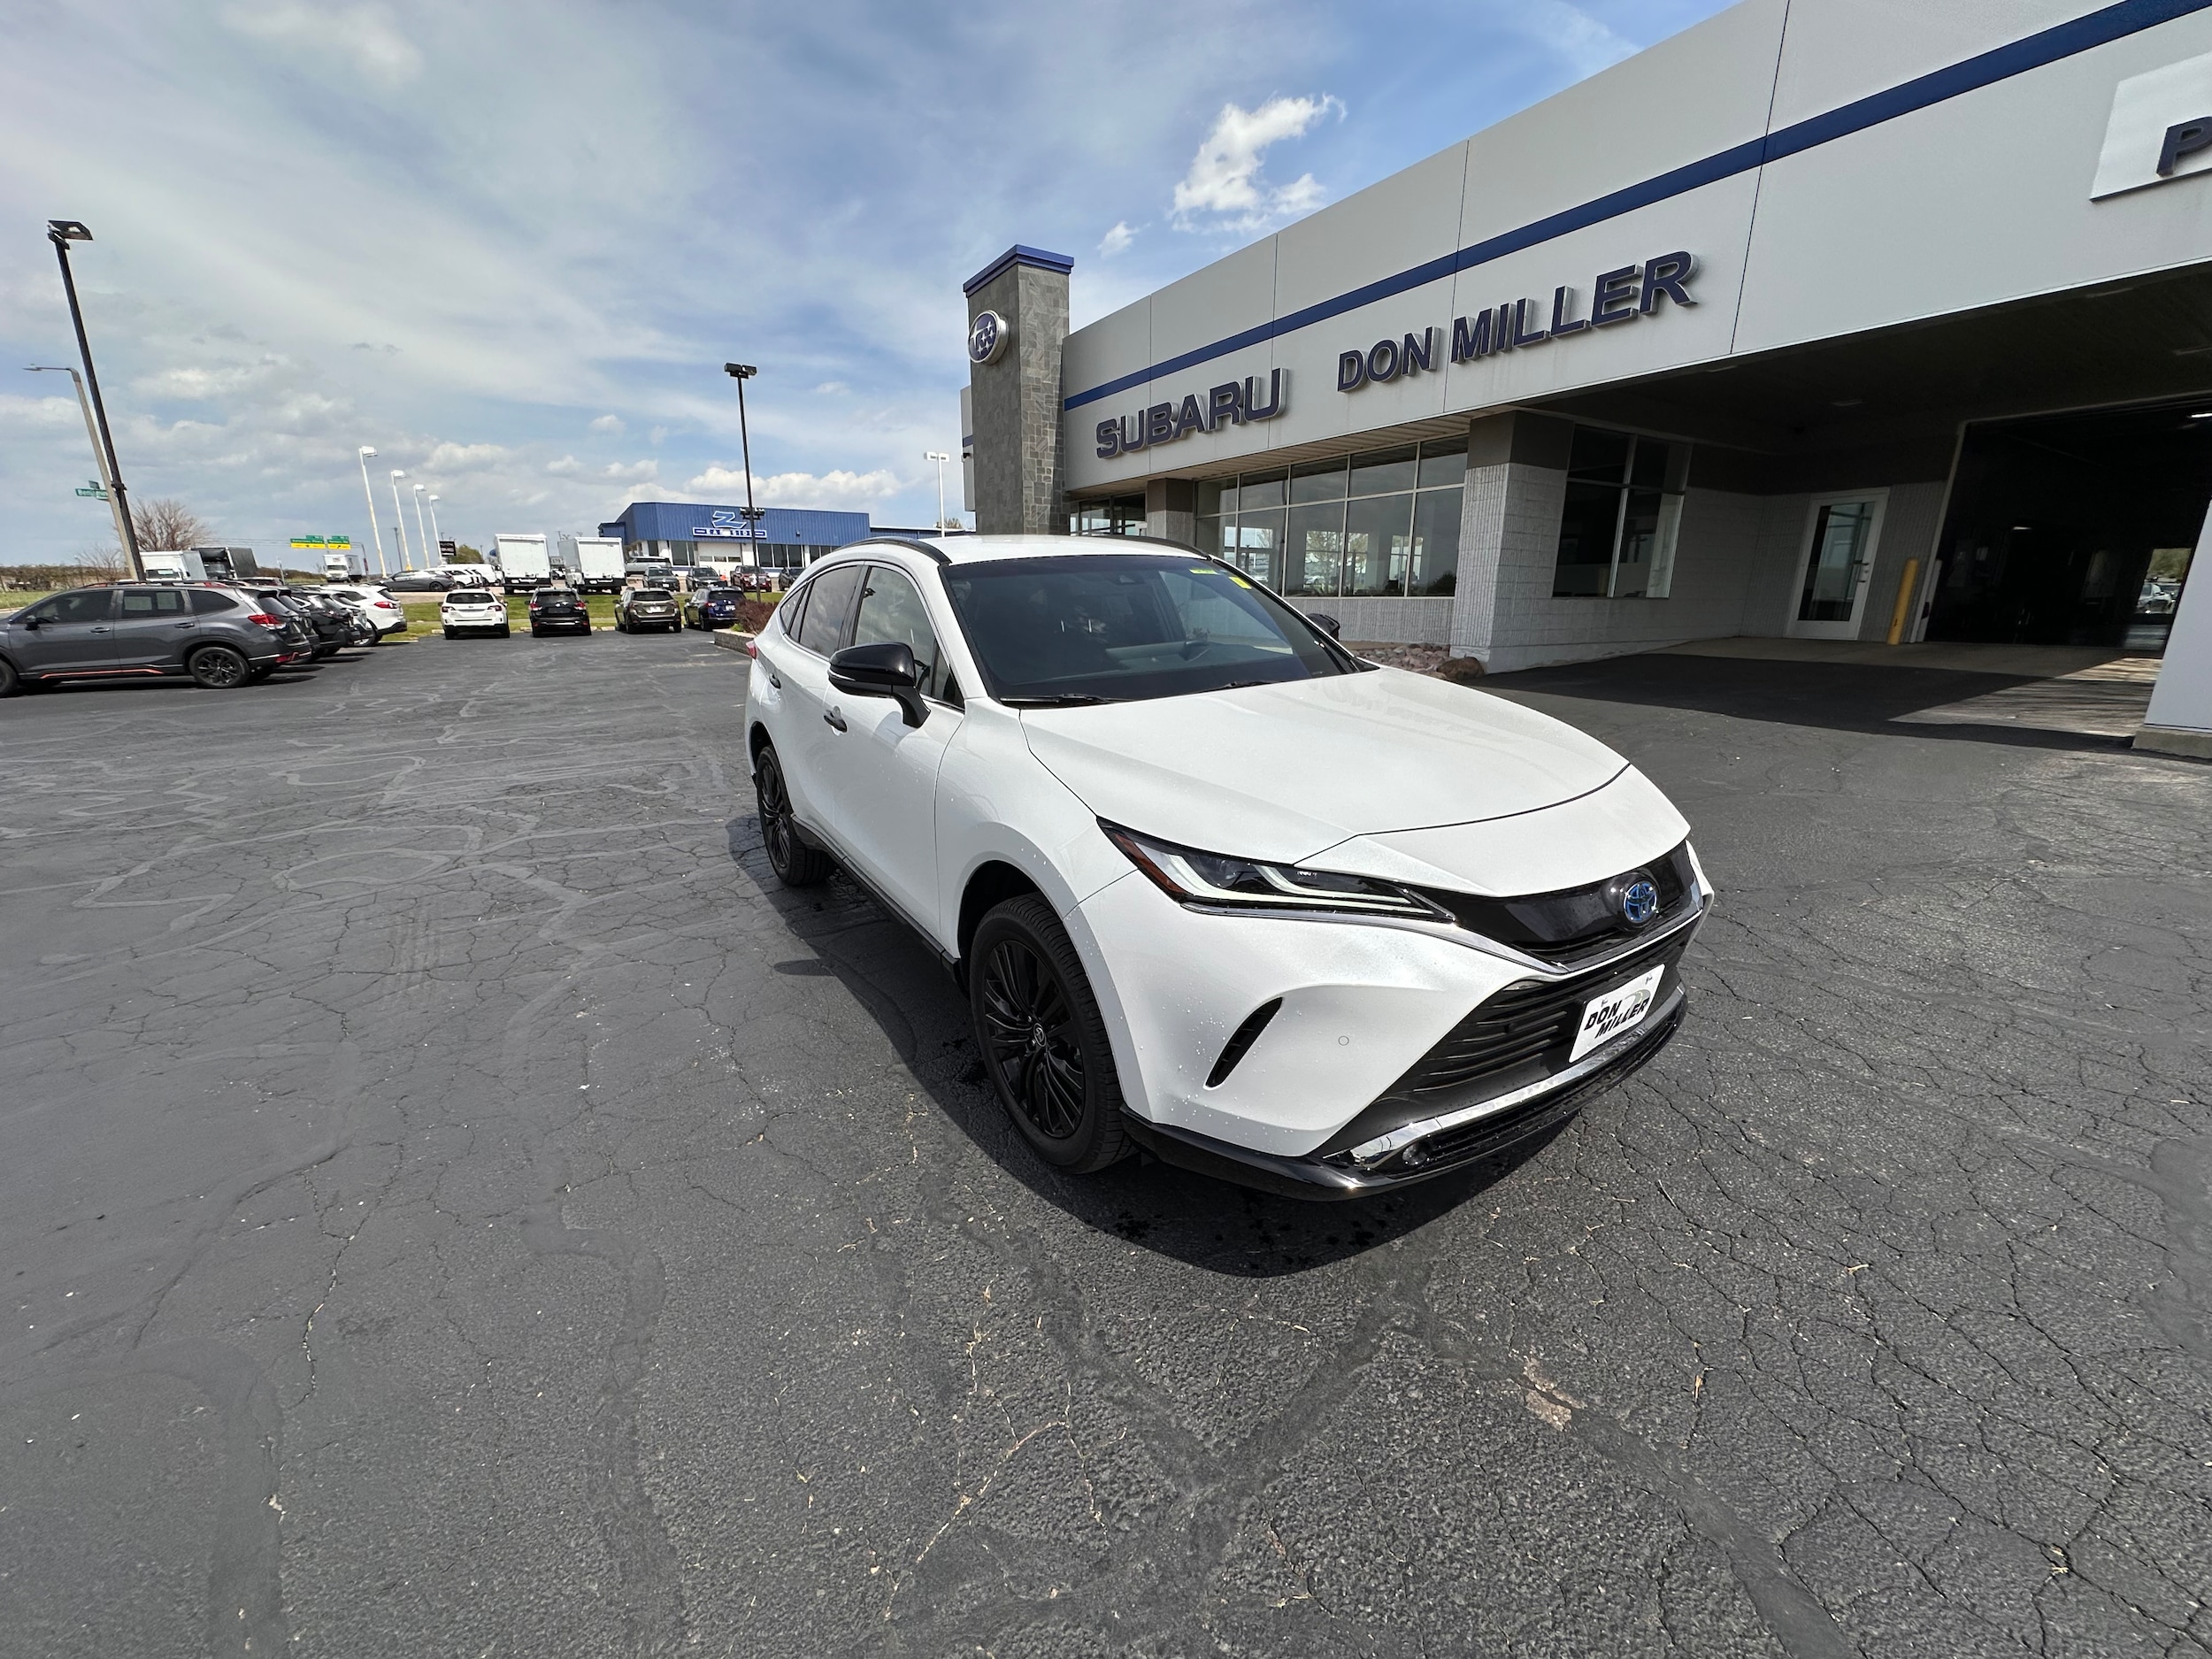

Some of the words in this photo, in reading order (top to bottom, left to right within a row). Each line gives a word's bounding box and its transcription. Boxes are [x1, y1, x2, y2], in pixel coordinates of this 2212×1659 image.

[2156, 116, 2212, 177] P
[1337, 326, 1440, 392] DON
[1451, 250, 1696, 364] MILLER
[1096, 367, 1286, 459] SUBARU
[1584, 1000, 1622, 1031] DON
[1594, 997, 1649, 1039] MILLER
